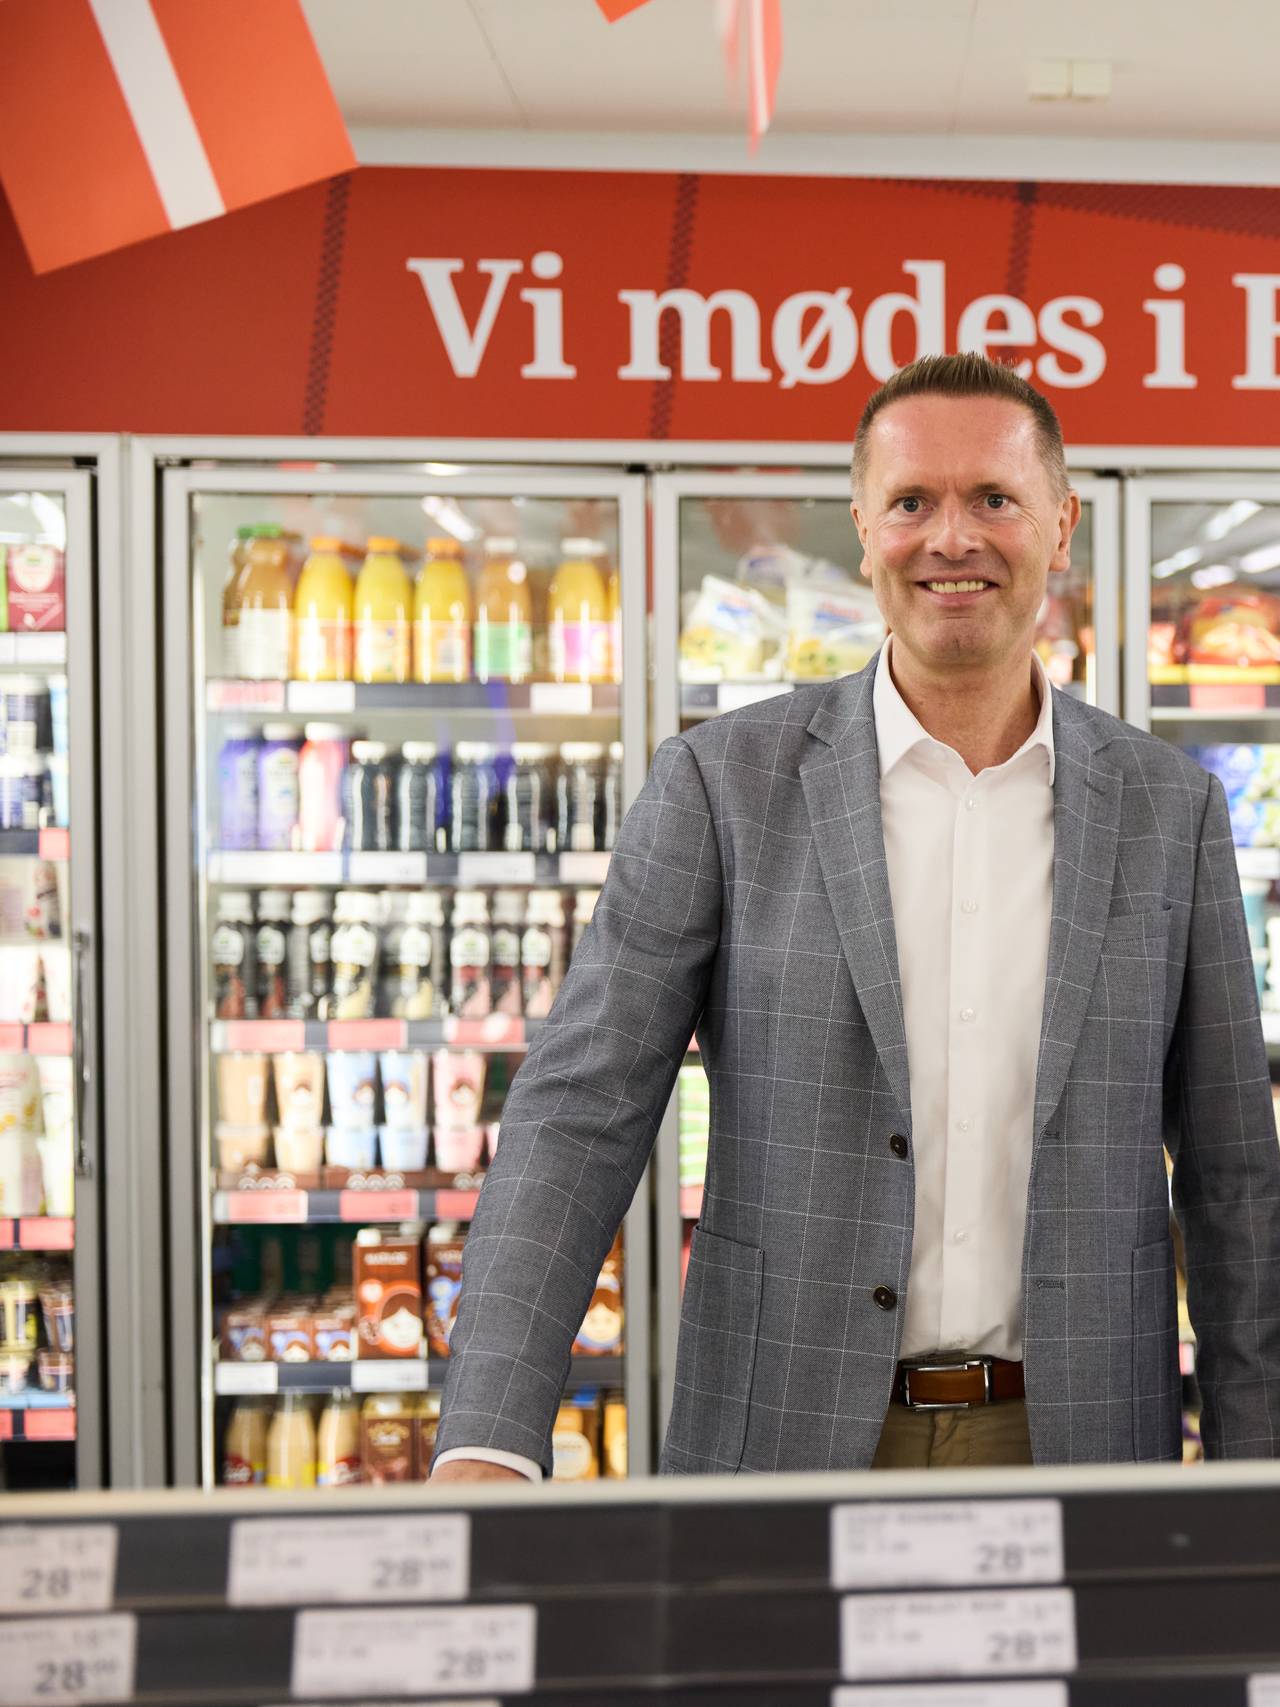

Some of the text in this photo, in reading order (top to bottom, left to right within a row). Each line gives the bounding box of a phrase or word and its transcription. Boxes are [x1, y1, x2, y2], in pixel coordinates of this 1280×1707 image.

[406, 251, 577, 380] Vi
[618, 260, 1106, 390] mødes
[1143, 263, 1198, 390] i
